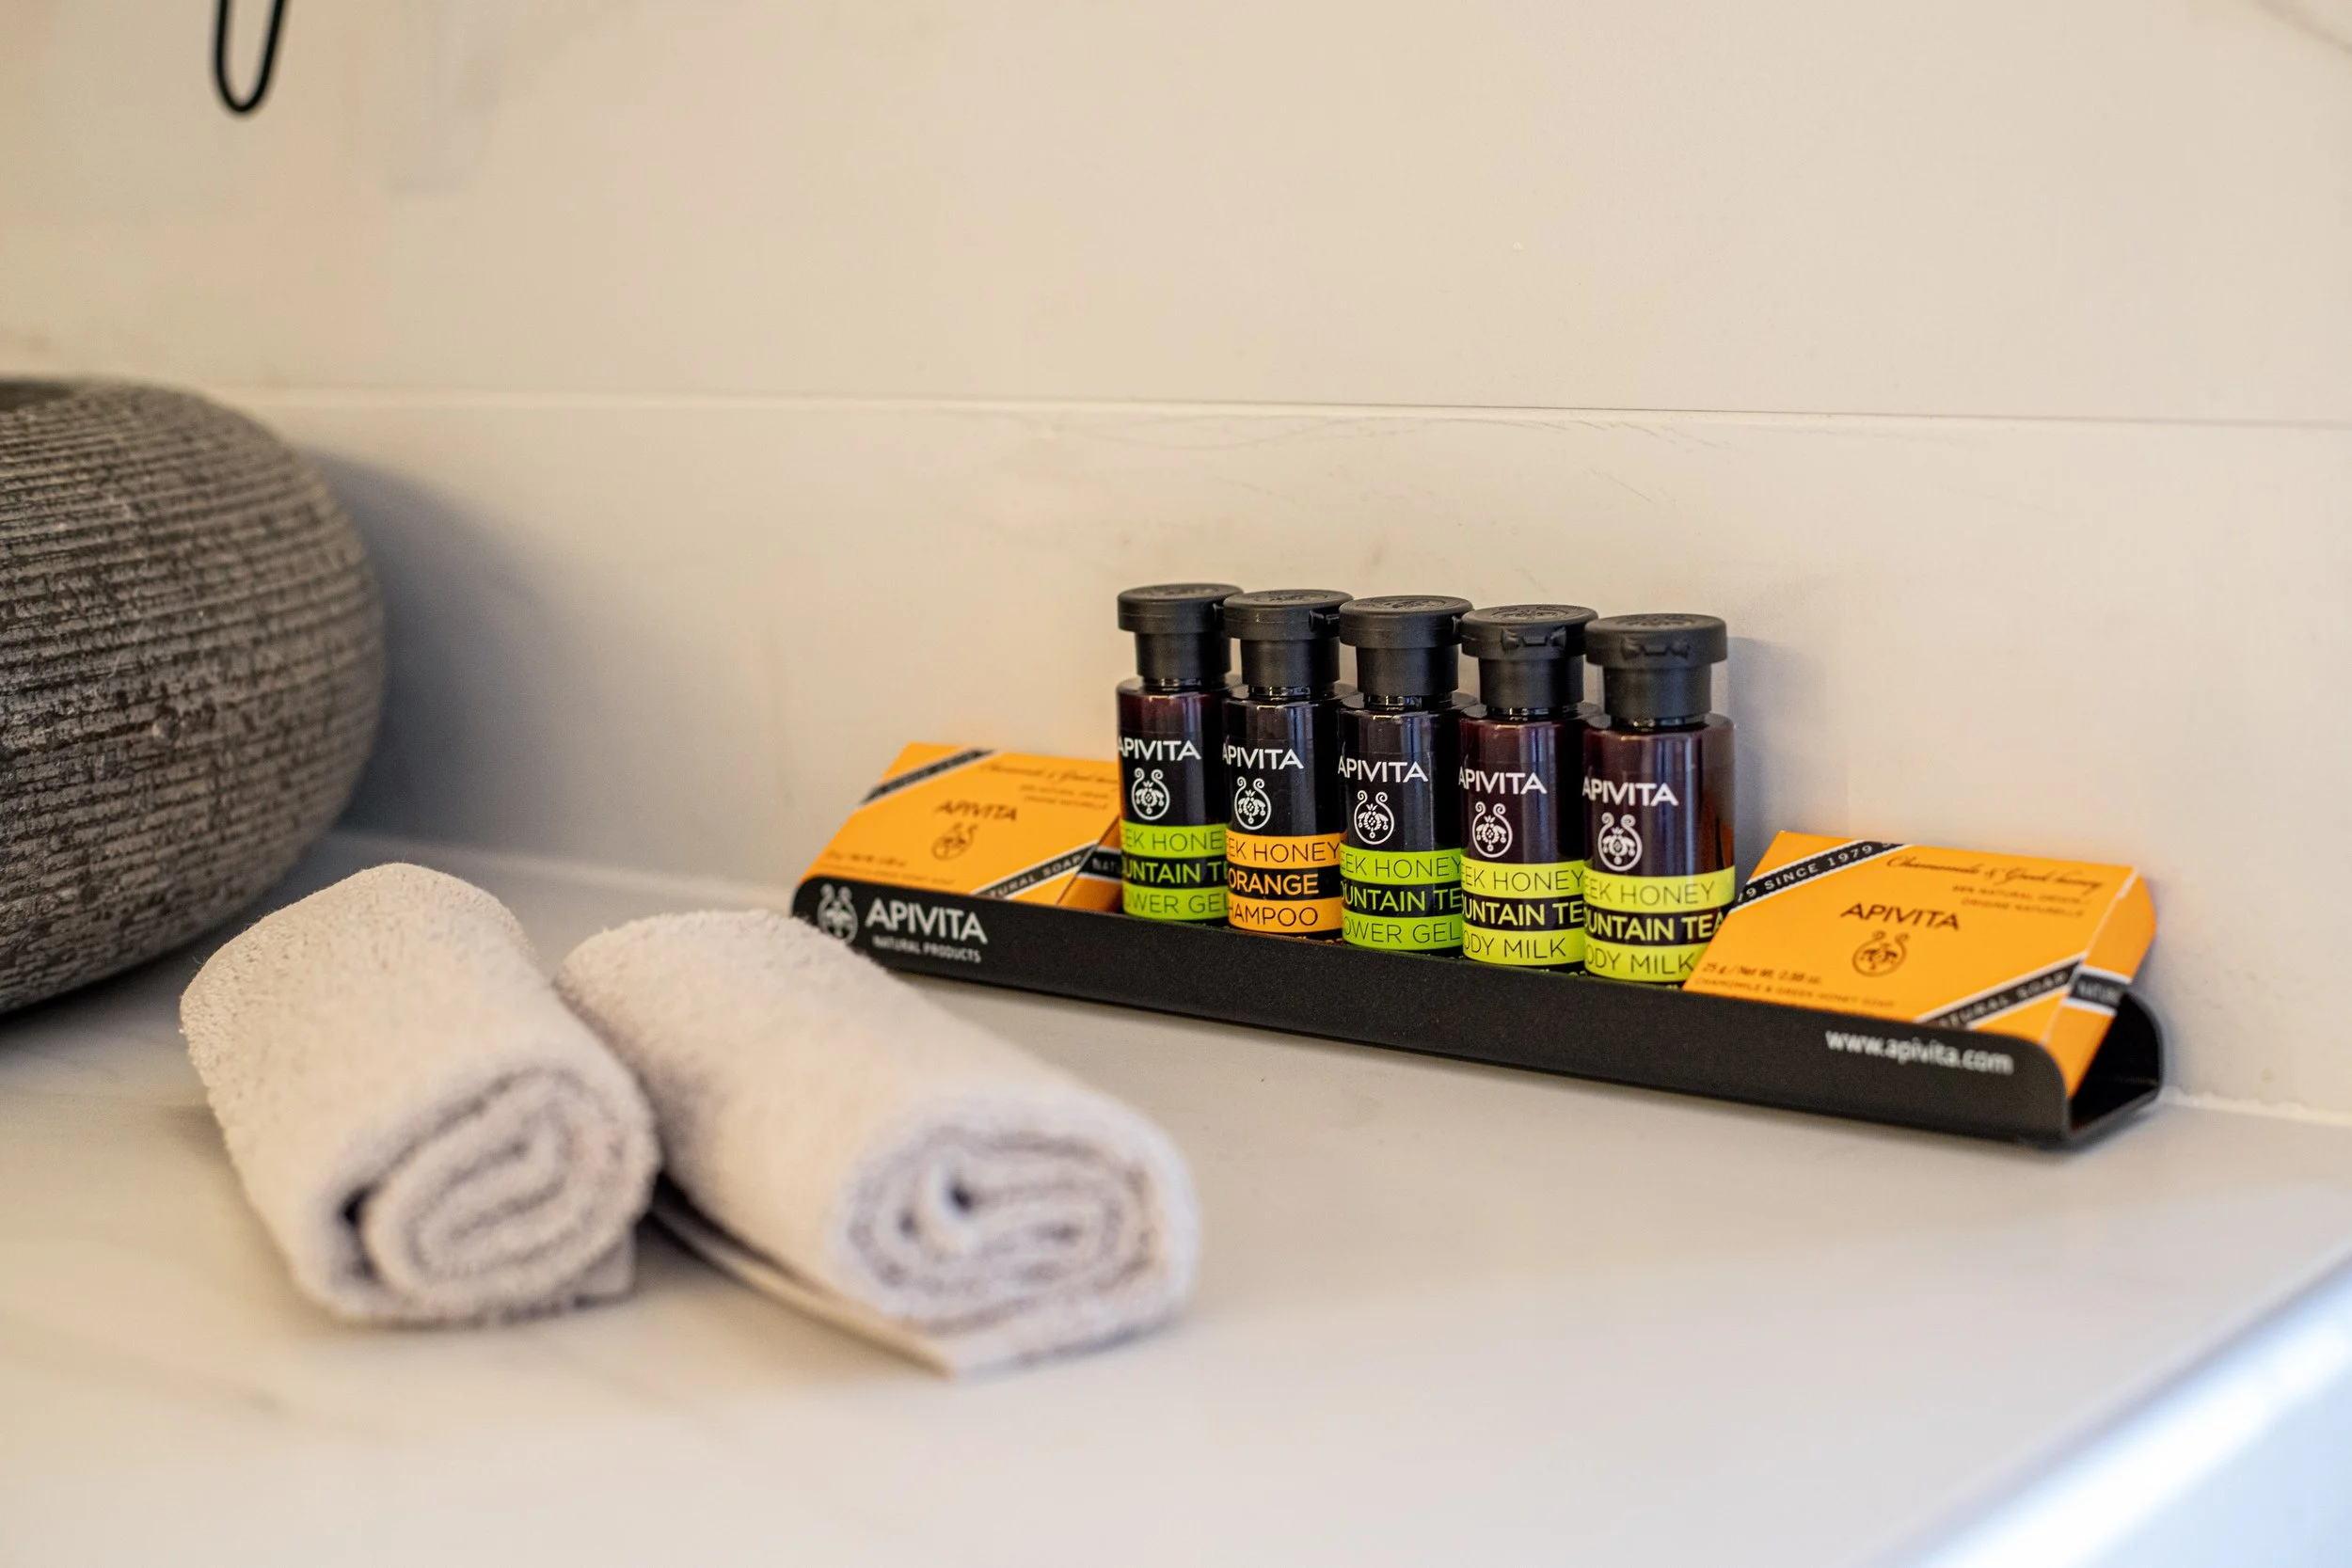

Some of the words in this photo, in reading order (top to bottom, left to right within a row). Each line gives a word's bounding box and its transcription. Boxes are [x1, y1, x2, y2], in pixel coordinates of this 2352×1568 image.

[1222, 743, 1304, 769] APIVITA
[1338, 755, 1429, 783] APIVITA
[1458, 767, 1548, 795] APIVITA
[1582, 776, 1678, 806] APIVITA
[1152, 831, 1224, 852] HONE
[1253, 841, 1340, 863] HONEY
[1124, 858, 1200, 883] UNTAIN
[1229, 867, 1319, 895] ORANGE
[1375, 856, 1461, 879] HONEY
[1494, 870, 1583, 892] HONEY
[1764, 863, 1819, 891] SINCE
[1828, 844, 1873, 867] 1979
[1434, 888, 1462, 910] TE
[1621, 880, 1715, 906] HONEY
[865, 897, 988, 944] APIVITA
[1230, 900, 1318, 927] HAMPOO
[1462, 895, 1545, 926] UNTAIN
[1552, 901, 1583, 924] TE
[1840, 903, 1960, 930] APIVITA
[1343, 916, 1402, 943] OWER
[1413, 922, 1461, 944] GEL
[1464, 930, 1494, 956] ODY
[1504, 937, 1566, 958] MILK
[871, 935, 921, 955] NATURAL
[923, 941, 981, 963] PRODUCTS
[1587, 944, 1621, 971] ODY
[1630, 952, 1694, 974] MILK
[1825, 1030, 2014, 1075] www.apivita.com
